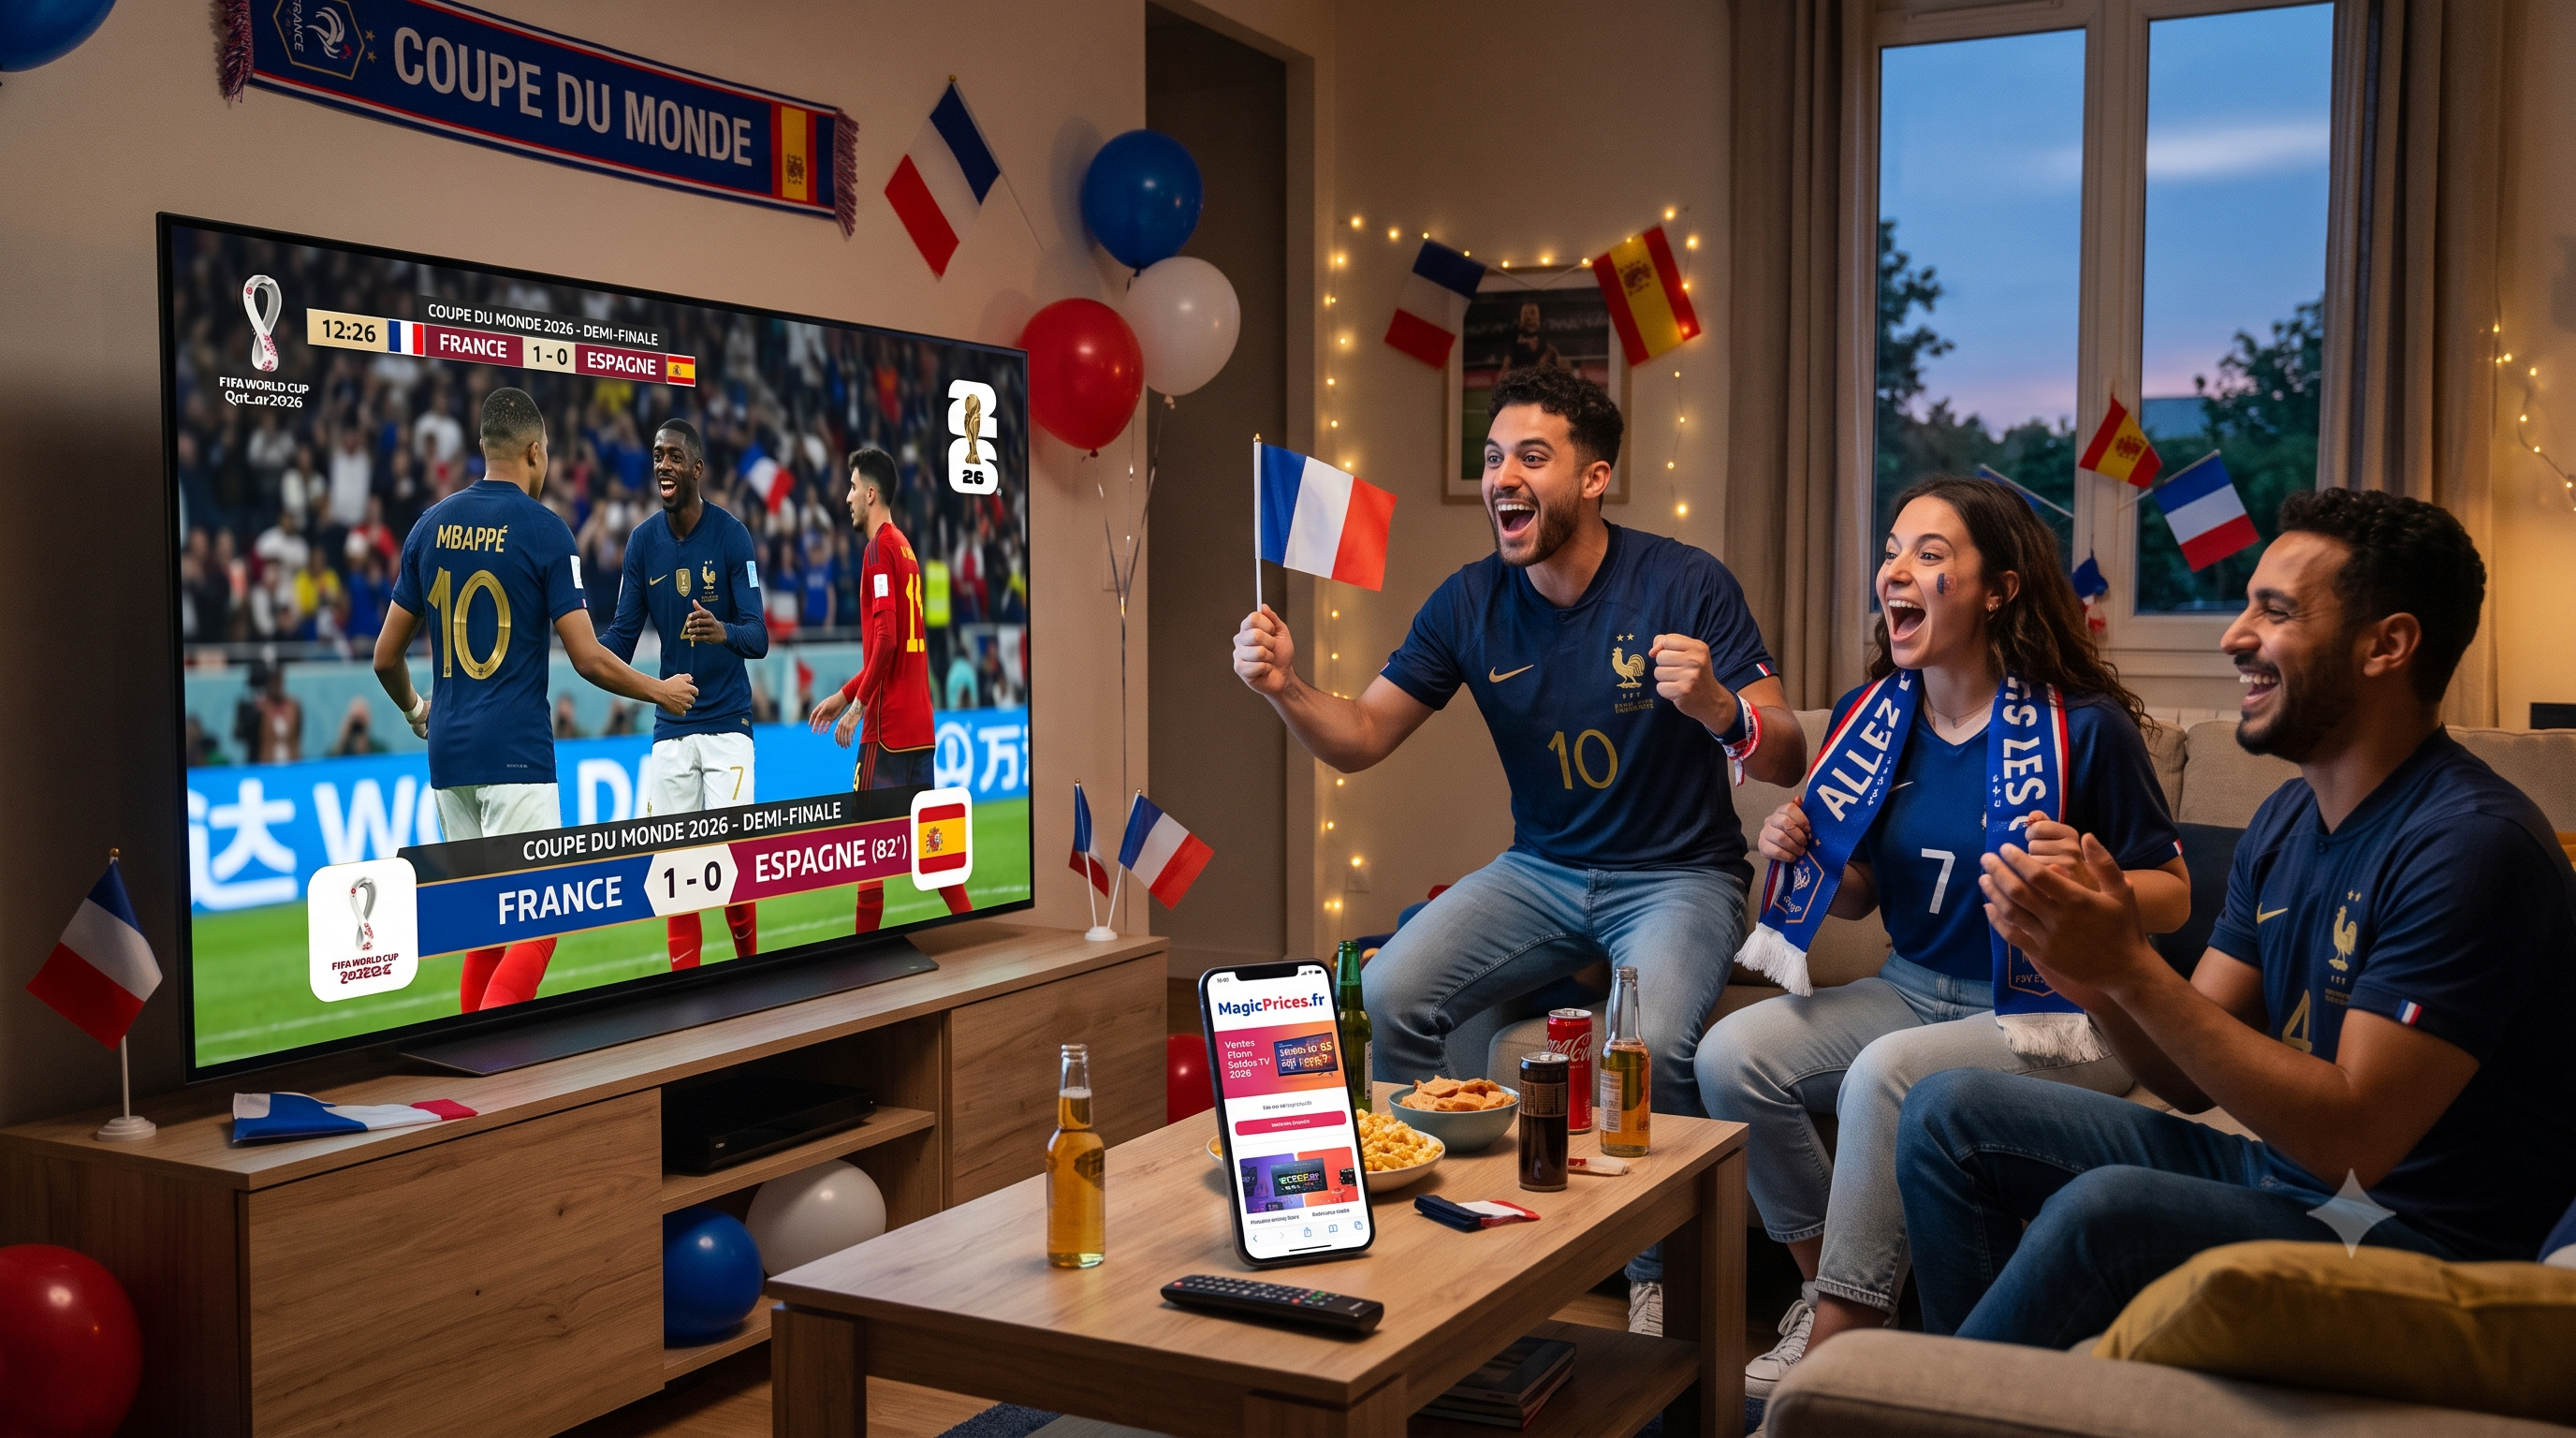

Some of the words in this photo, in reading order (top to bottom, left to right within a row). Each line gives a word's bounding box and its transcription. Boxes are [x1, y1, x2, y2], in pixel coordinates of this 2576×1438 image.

[394, 26, 543, 118] COUPE
[557, 71, 610, 134] DU
[624, 90, 753, 167] MONDE
[322, 319, 376, 343] 12:26
[428, 303, 472, 322] COUPE
[475, 310, 493, 325] DU
[496, 313, 542, 331] MONDE
[544, 319, 574, 335] 2026
[583, 325, 659, 346] DEMI-FINALE
[440, 333, 507, 359] FRANCE
[587, 351, 657, 375] ESPAGNE
[219, 376, 244, 389] FIFA
[245, 378, 285, 392] WORLD
[287, 383, 310, 394] CUP
[962, 469, 985, 485] 26
[435, 524, 508, 552] MBAPPÉ
[427, 565, 512, 680] 10
[1547, 728, 1619, 790] 10
[1816, 698, 1901, 822] ALLEZ
[729, 766, 744, 800] 7
[522, 837, 587, 861] COUPE
[591, 829, 617, 852] DU
[621, 822, 684, 848] MONDE
[689, 816, 728, 839] 2026
[742, 801, 842, 831] DEMI-FINALE
[498, 875, 623, 925] FRANCE
[755, 839, 867, 883] ESPAGNE
[871, 834, 907, 864] (82')
[1921, 847, 1956, 915] 7
[331, 961, 352, 971] FIFA
[352, 955, 382, 967] WORLD
[383, 953, 399, 962] CUP
[1218, 992, 1325, 1017] MagicPrices.fr
[2281, 989, 2313, 1054] 4
[1224, 1039, 1255, 1049] Ventes
[1257, 1058, 1270, 1066] TV
[1229, 1070, 1252, 1079] 2026
